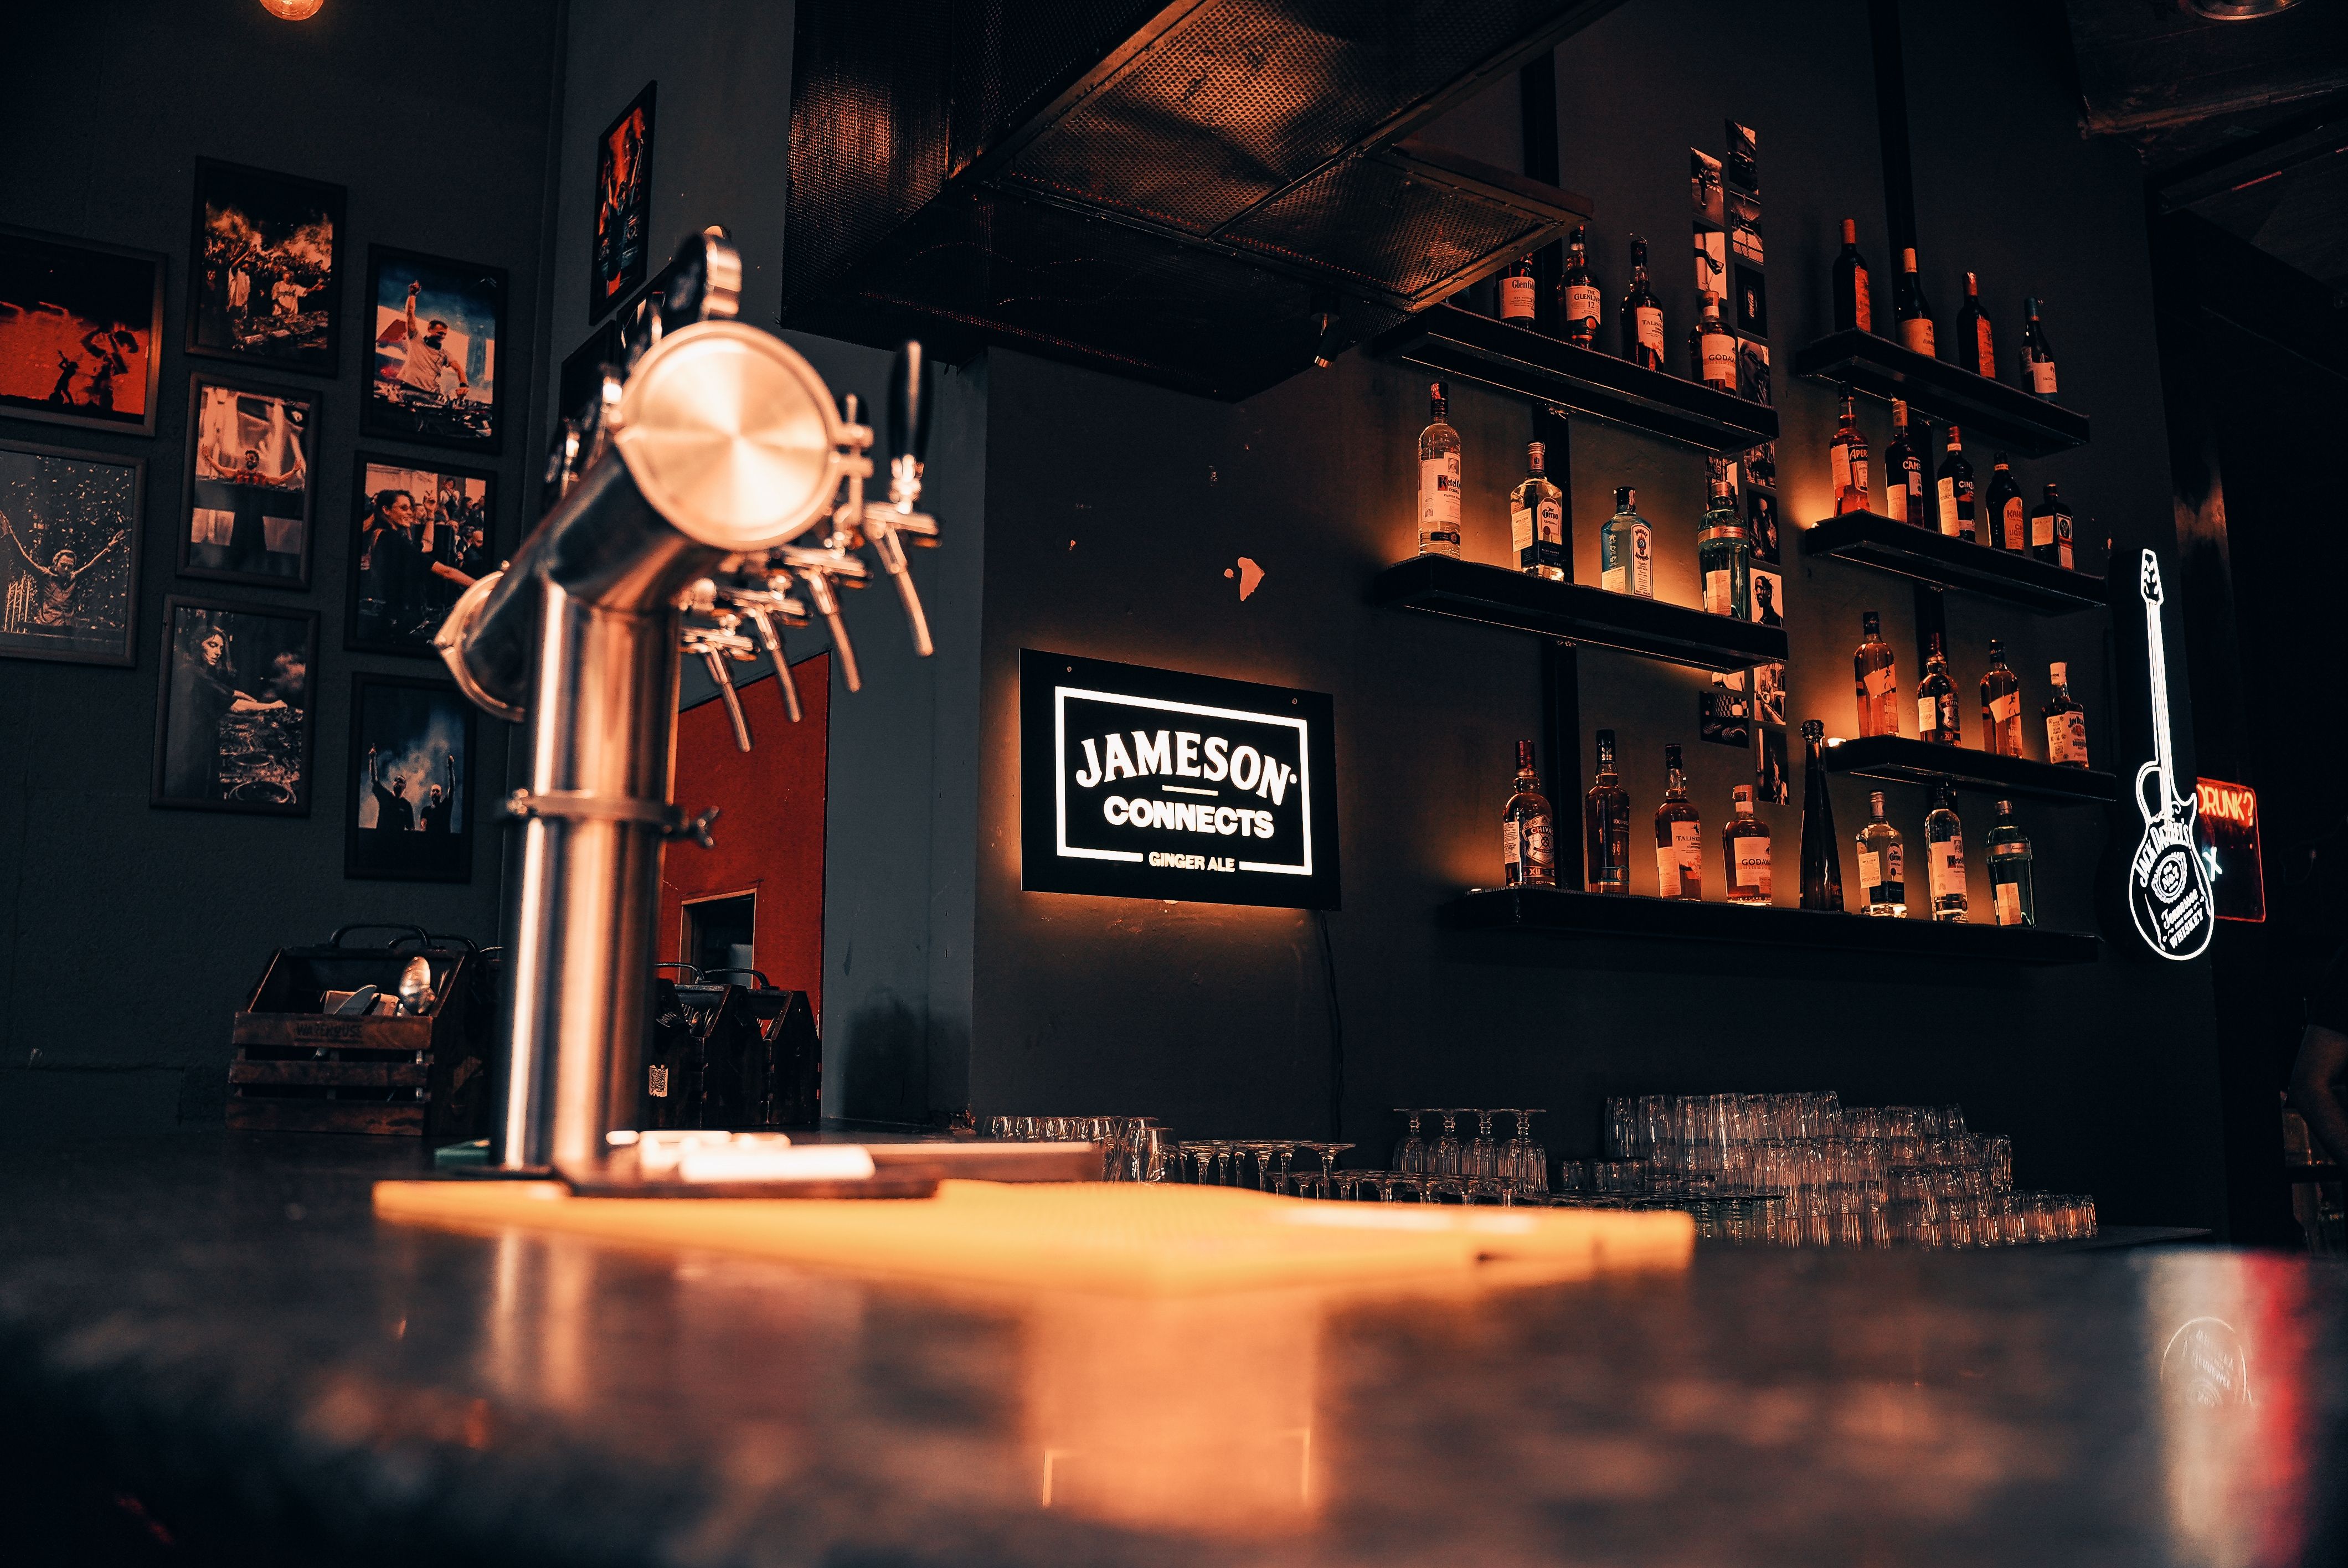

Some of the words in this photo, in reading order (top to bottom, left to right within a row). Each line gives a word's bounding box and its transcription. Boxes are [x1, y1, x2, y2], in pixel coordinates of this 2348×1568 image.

[1574, 293, 1600, 304] GLENLIVE
[1588, 301, 1595, 309] 12
[1075, 730, 1291, 806] JAMESON
[1103, 795, 1275, 839] CONNECTS
[1149, 852, 1205, 870] GINGER
[1207, 856, 1235, 873] ALE
[2135, 839, 2159, 888] JACK
[2169, 907, 2203, 949] WHISKEY
